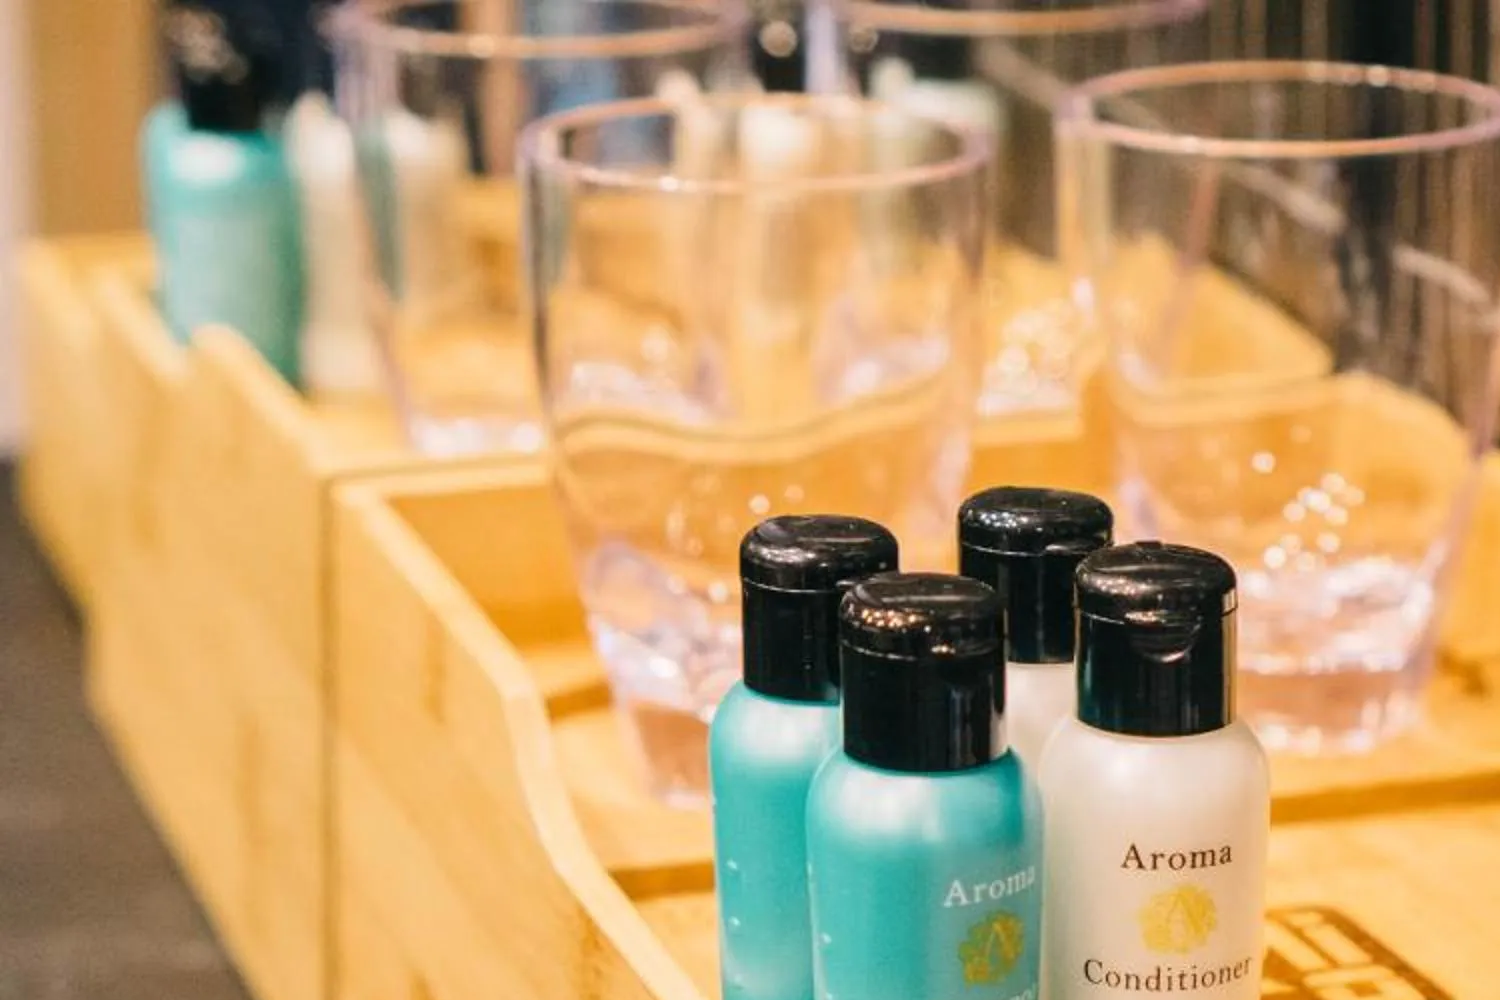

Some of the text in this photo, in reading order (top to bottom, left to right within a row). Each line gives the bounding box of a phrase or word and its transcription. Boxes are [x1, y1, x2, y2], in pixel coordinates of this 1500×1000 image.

[1120, 842, 1233, 872] Aroma
[943, 866, 1036, 908] Aroma
[1083, 954, 1253, 993] Conditioner
